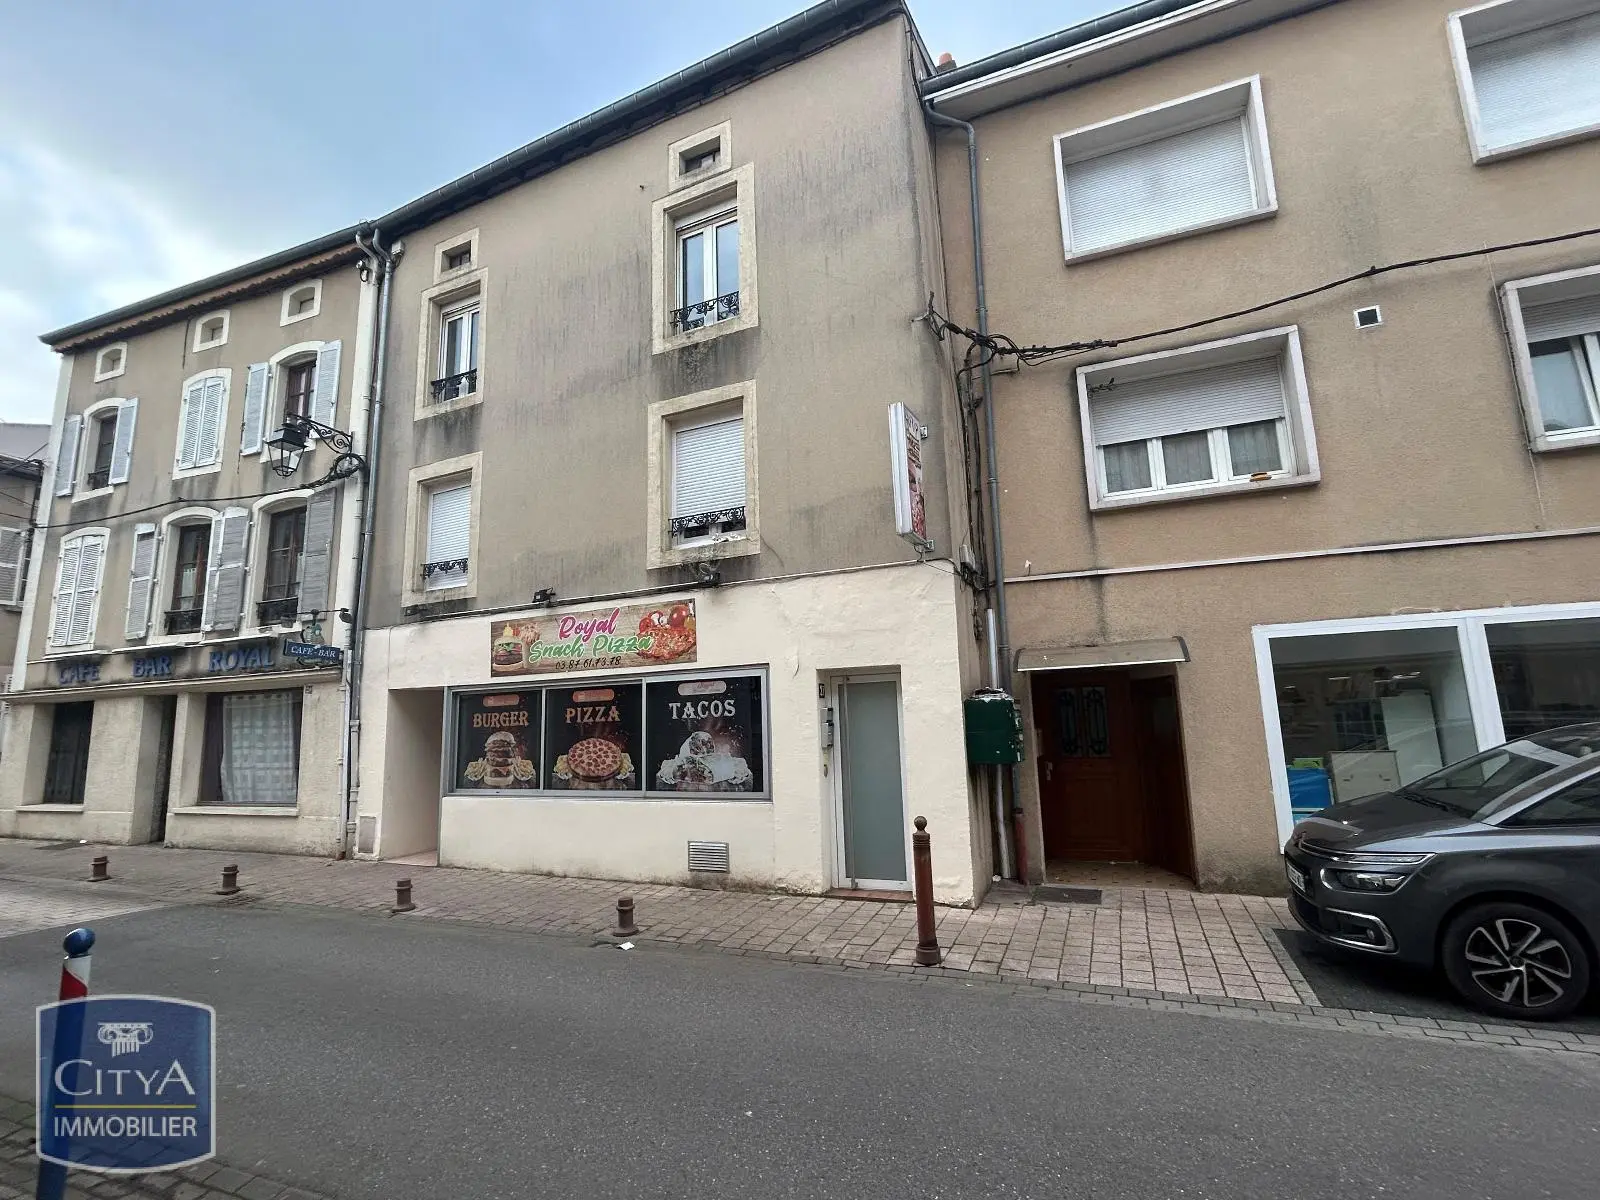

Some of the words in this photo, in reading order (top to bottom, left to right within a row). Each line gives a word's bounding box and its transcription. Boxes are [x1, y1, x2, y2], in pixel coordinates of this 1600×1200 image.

[559, 607, 620, 643] Royal
[593, 634, 653, 657] Pizza
[132, 656, 172, 678] BAR
[208, 647, 274, 672] ROYAL
[555, 655, 622, 670] 03.87.61.73.78
[473, 711, 529, 728] BURGER
[565, 705, 621, 724] PIZZA
[668, 699, 736, 720] TACOS
